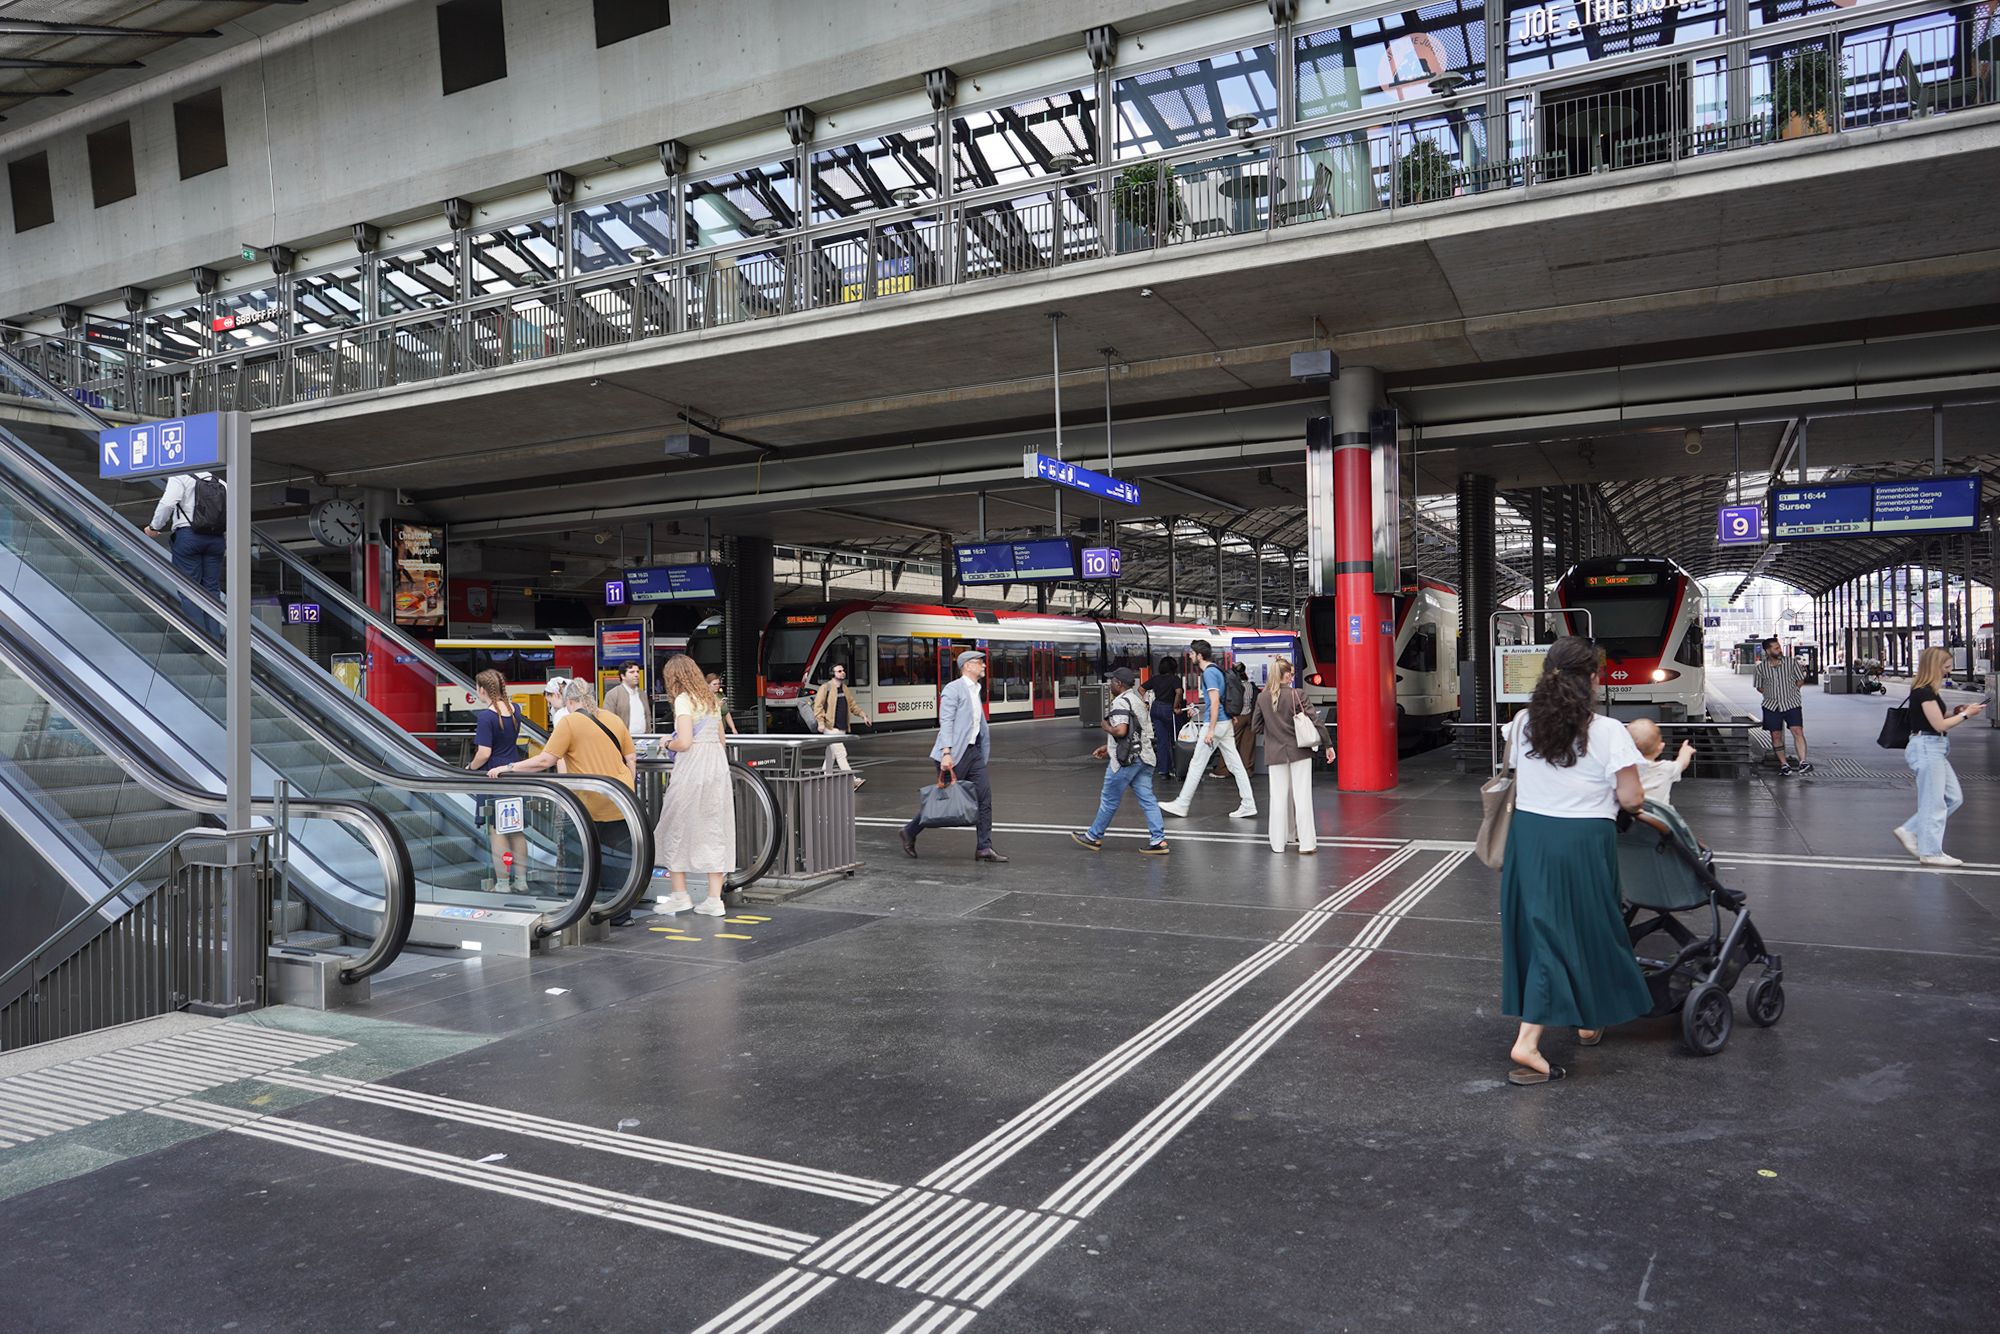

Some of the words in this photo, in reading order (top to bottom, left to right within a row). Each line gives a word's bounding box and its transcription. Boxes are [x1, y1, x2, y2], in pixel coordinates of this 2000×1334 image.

[1519, 5, 1560, 40] JOE
[235, 313, 251, 326] SBB
[1803, 491, 1827, 500] 16:44
[1778, 503, 1811, 511] Sursee
[1875, 499, 1918, 507] Emmenbrücke
[1732, 517, 1748, 536] 9
[1086, 557, 1105, 573] 10
[1111, 556, 1120, 573] 10
[1589, 577, 1598, 585] S1
[1605, 576, 1629, 584] Sursee
[609, 588, 620, 601] 11
[290, 609, 299, 621] 12
[304, 609, 317, 621] 12
[897, 702, 910, 711] SBB
[910, 701, 922, 710] CFF
[922, 701, 934, 710] FFS
